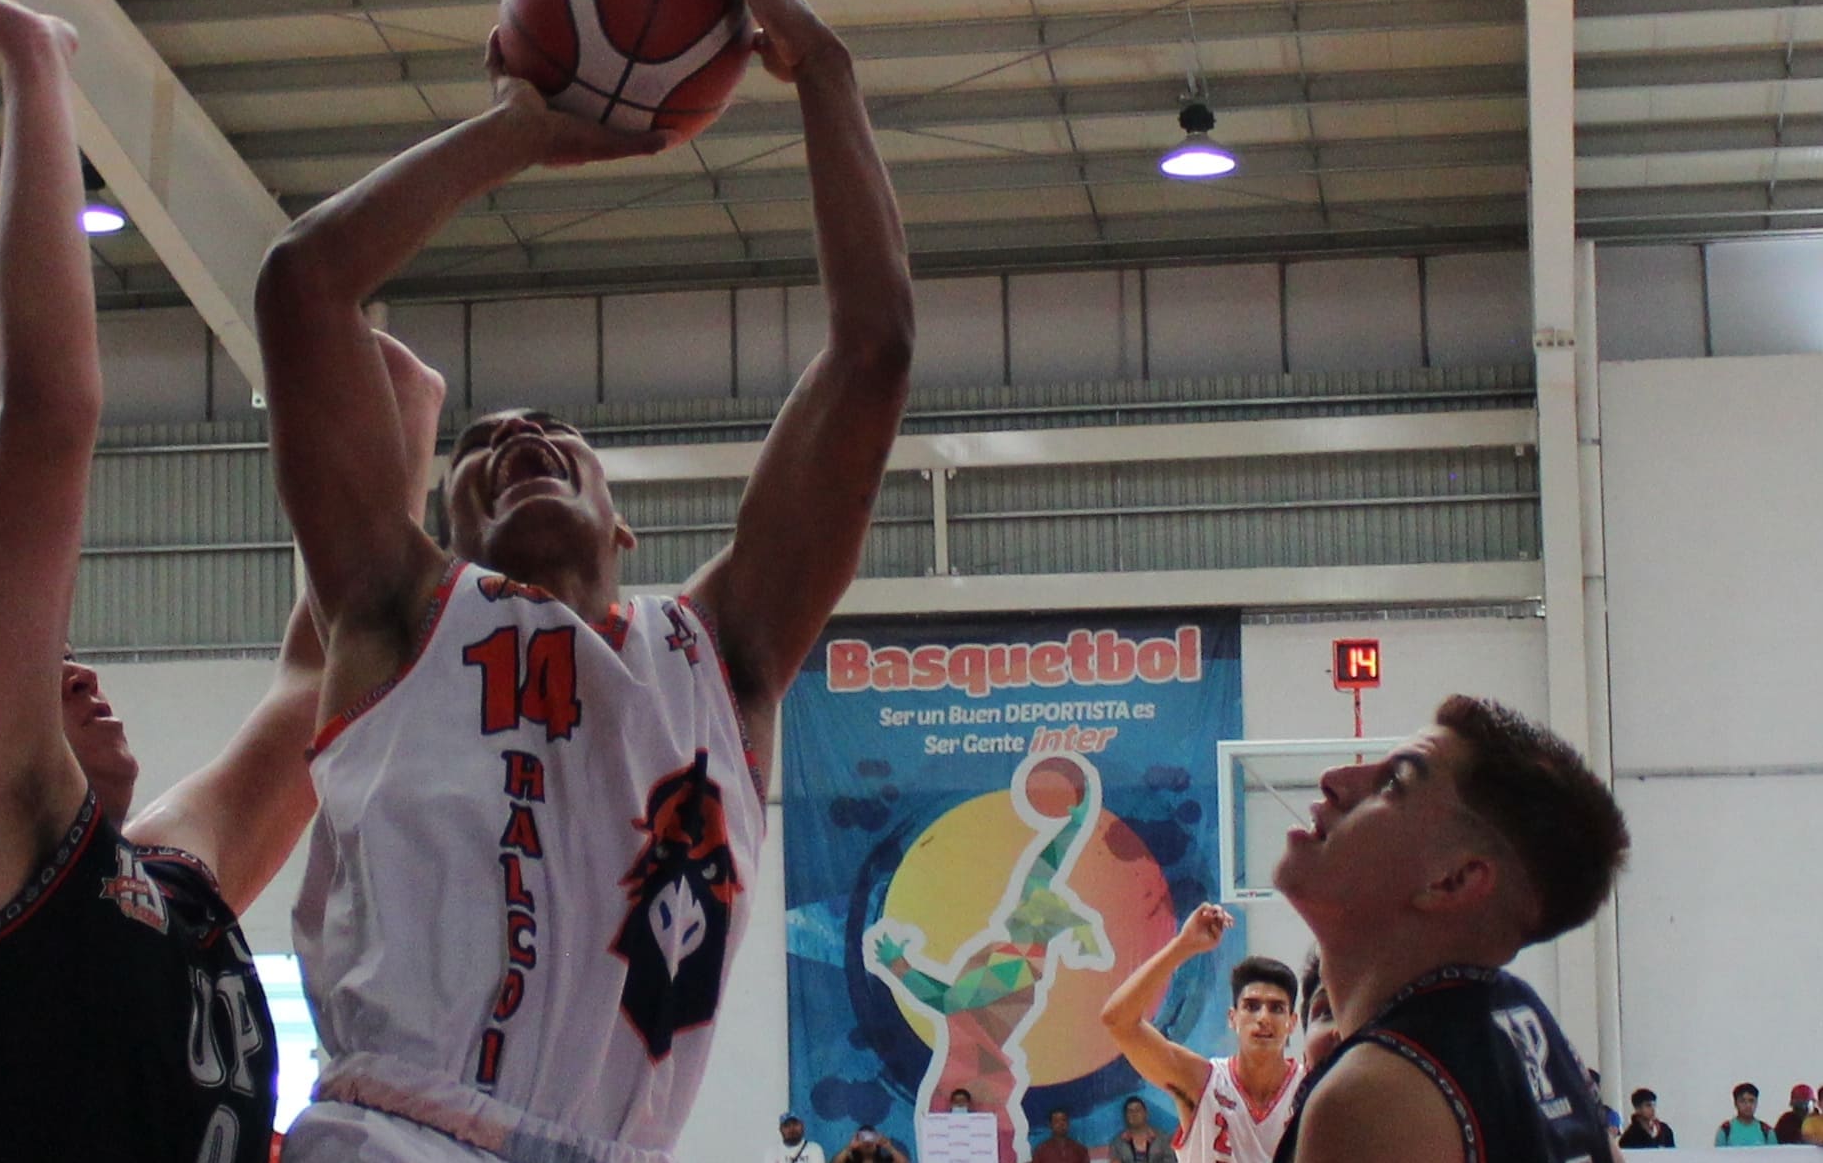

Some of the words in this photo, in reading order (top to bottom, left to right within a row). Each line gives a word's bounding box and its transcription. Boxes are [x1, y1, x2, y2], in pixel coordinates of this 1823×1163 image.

[827, 625, 1201, 698] Basquetbol
[1349, 647, 1376, 677] 14
[462, 625, 582, 743] 14
[880, 707, 915, 726] Ser
[917, 709, 946, 725] un
[948, 704, 1001, 725] Buen
[1005, 700, 1131, 722] DEPORTISTA
[1132, 702, 1156, 720] es
[924, 736, 956, 755] Ser
[963, 735, 1025, 754] Gente
[1029, 726, 1118, 754] inter
[1213, 1112, 1233, 1156] 2
